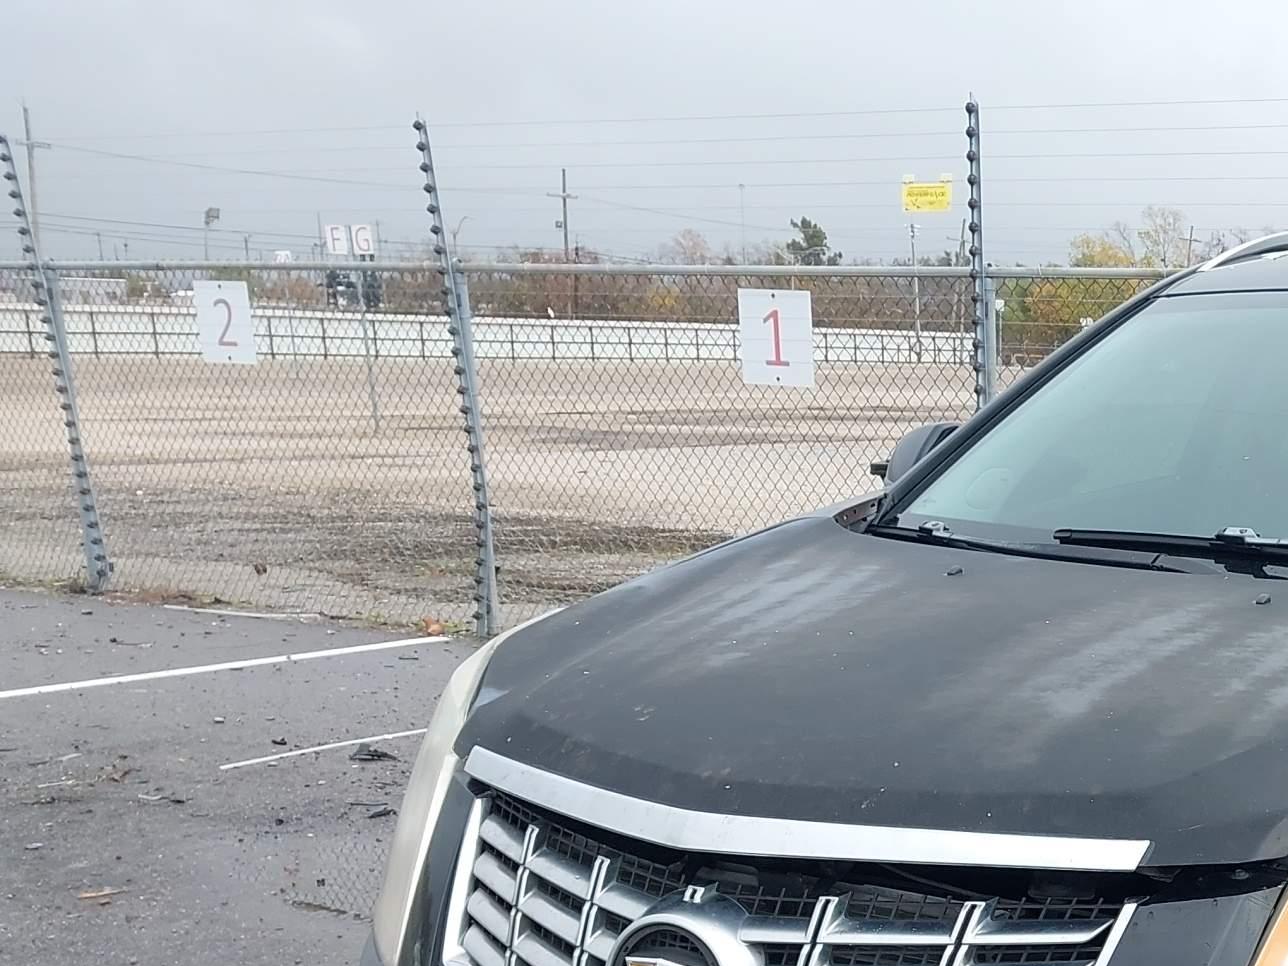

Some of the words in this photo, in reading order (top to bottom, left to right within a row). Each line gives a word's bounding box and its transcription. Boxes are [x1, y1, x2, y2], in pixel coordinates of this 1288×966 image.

[329, 226, 341, 252] F
[355, 226, 371, 252] G
[213, 298, 238, 347] 2
[762, 308, 790, 366] 1
